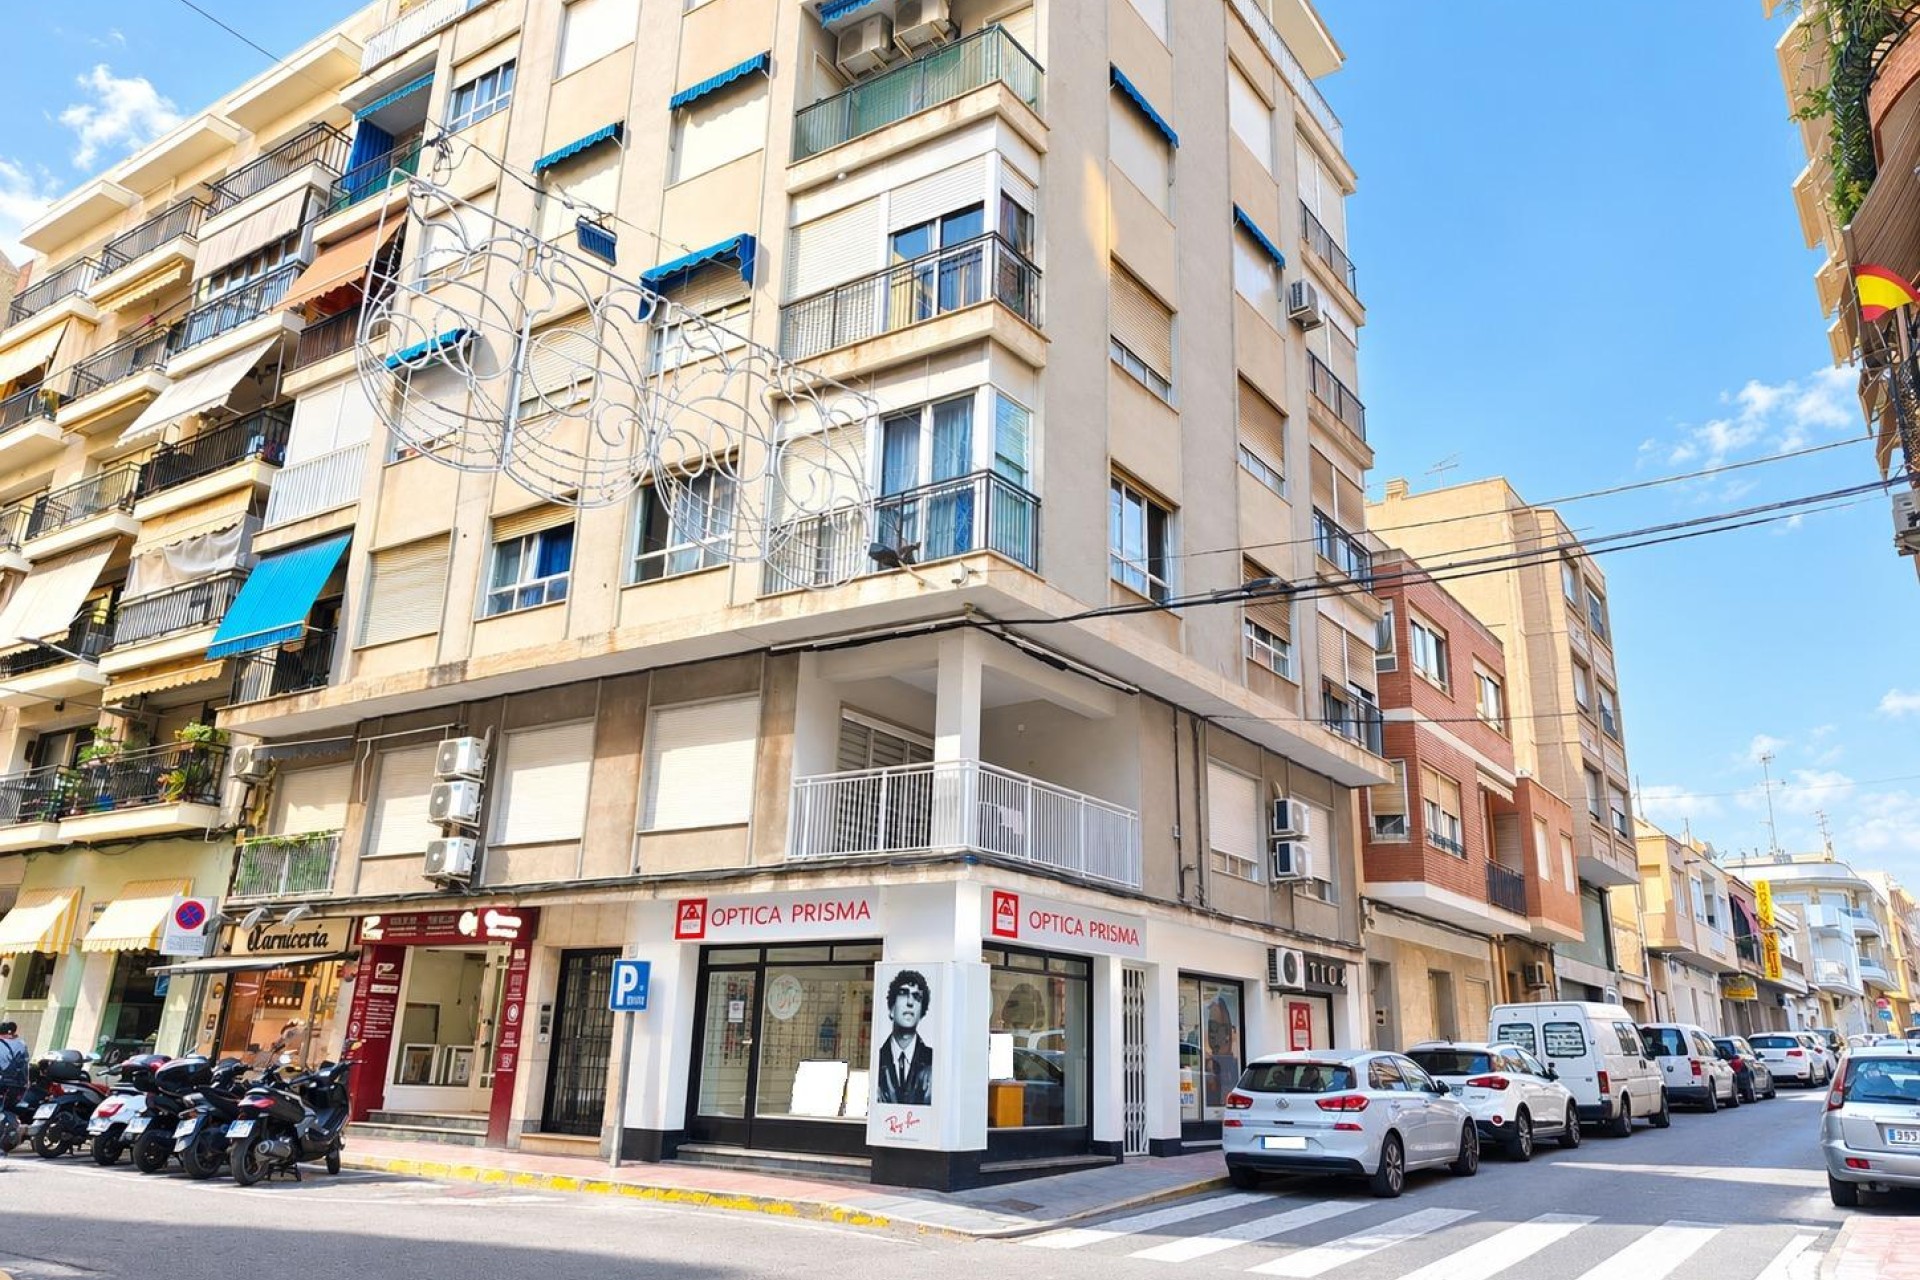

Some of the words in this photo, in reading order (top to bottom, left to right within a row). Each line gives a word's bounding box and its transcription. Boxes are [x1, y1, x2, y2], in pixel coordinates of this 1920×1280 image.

[711, 906, 782, 927] OPTICA
[791, 900, 871, 923] PRISMA
[1028, 910, 1084, 936] OPTICA
[1089, 920, 1140, 946] PRISMA
[616, 964, 639, 1006] P
